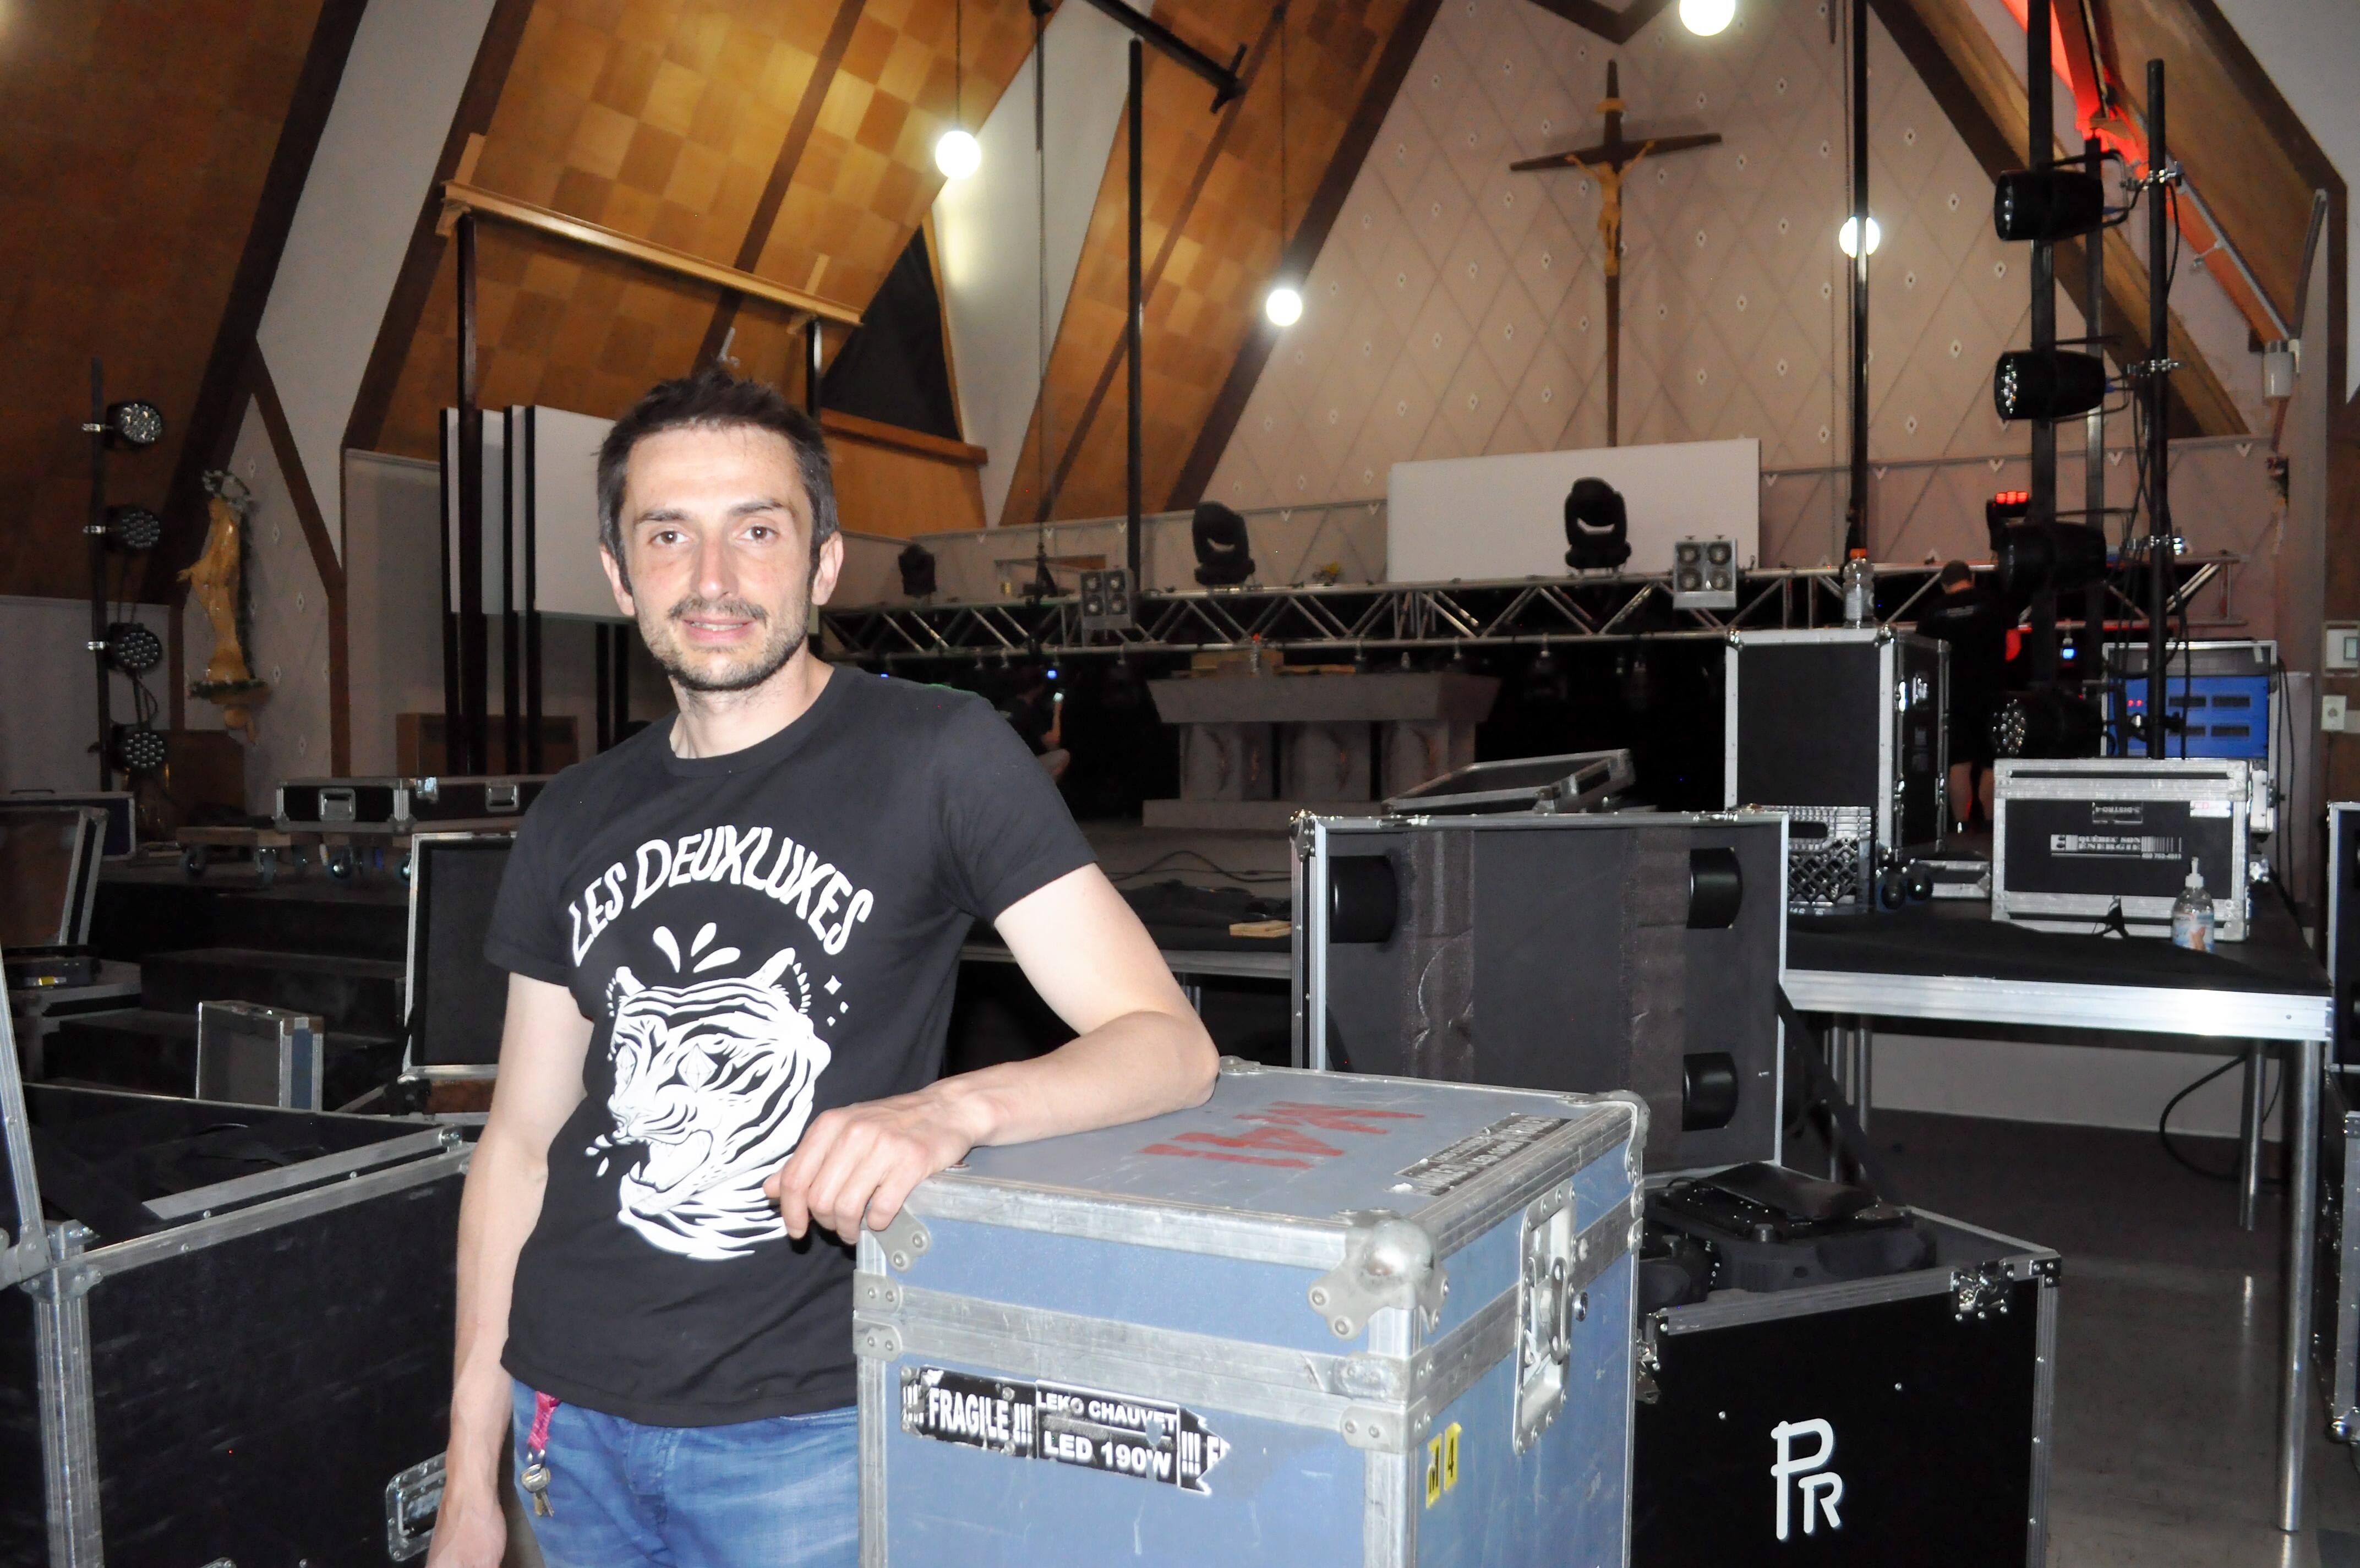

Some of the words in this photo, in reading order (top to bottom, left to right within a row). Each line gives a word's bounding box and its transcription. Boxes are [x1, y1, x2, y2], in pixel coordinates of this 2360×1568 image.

[569, 861, 627, 967] LES
[631, 824, 874, 955] DEUXLUXES
[928, 1387, 1009, 1441] FRAGILE
[1036, 1391, 1084, 1414] LEKO
[1045, 1430, 1093, 1463] LED
[1101, 1441, 1171, 1478] 190W
